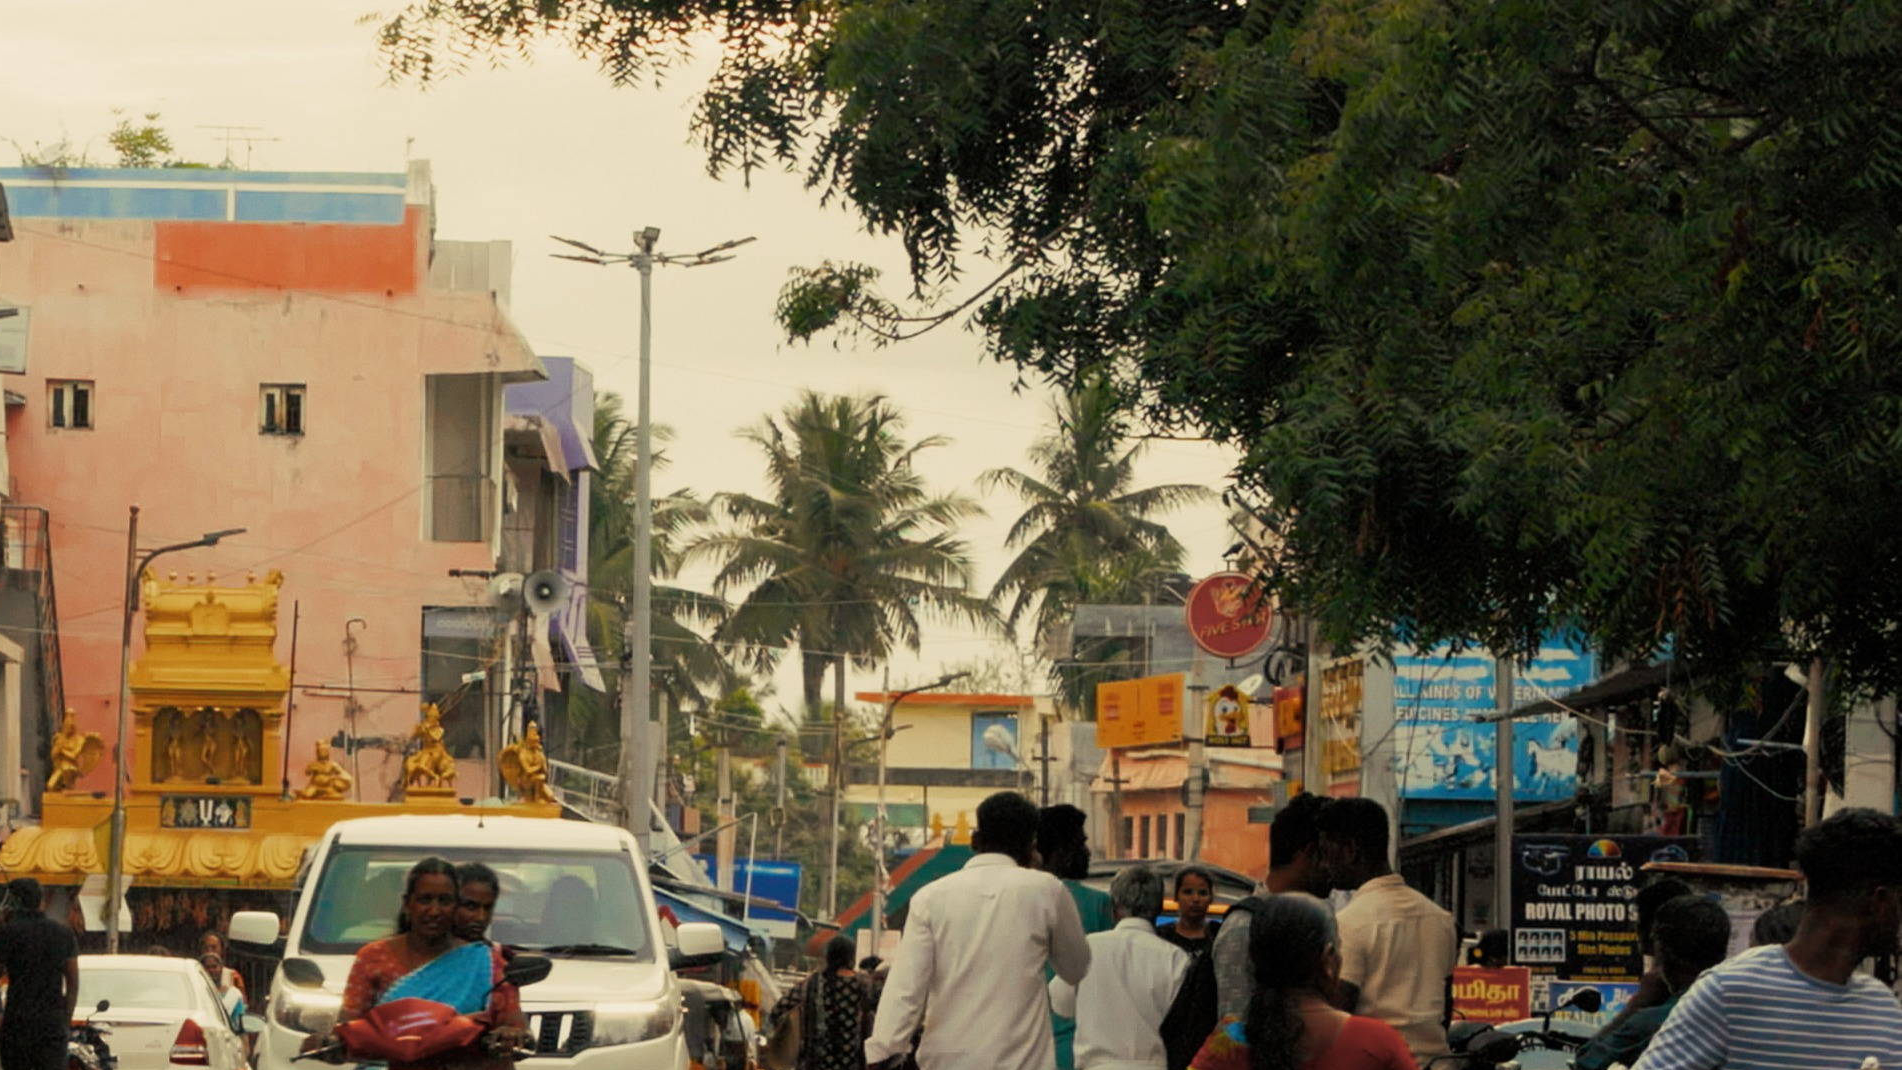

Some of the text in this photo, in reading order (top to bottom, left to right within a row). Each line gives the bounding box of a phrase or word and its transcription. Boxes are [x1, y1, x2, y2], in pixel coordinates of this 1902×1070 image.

[1465, 686, 1483, 698] OF
[1487, 685, 1570, 700] VERINARY
[1525, 902, 1572, 921] ROYAL
[1575, 902, 1626, 921] PHOTO
[1576, 943, 1632, 955] Size Photos
